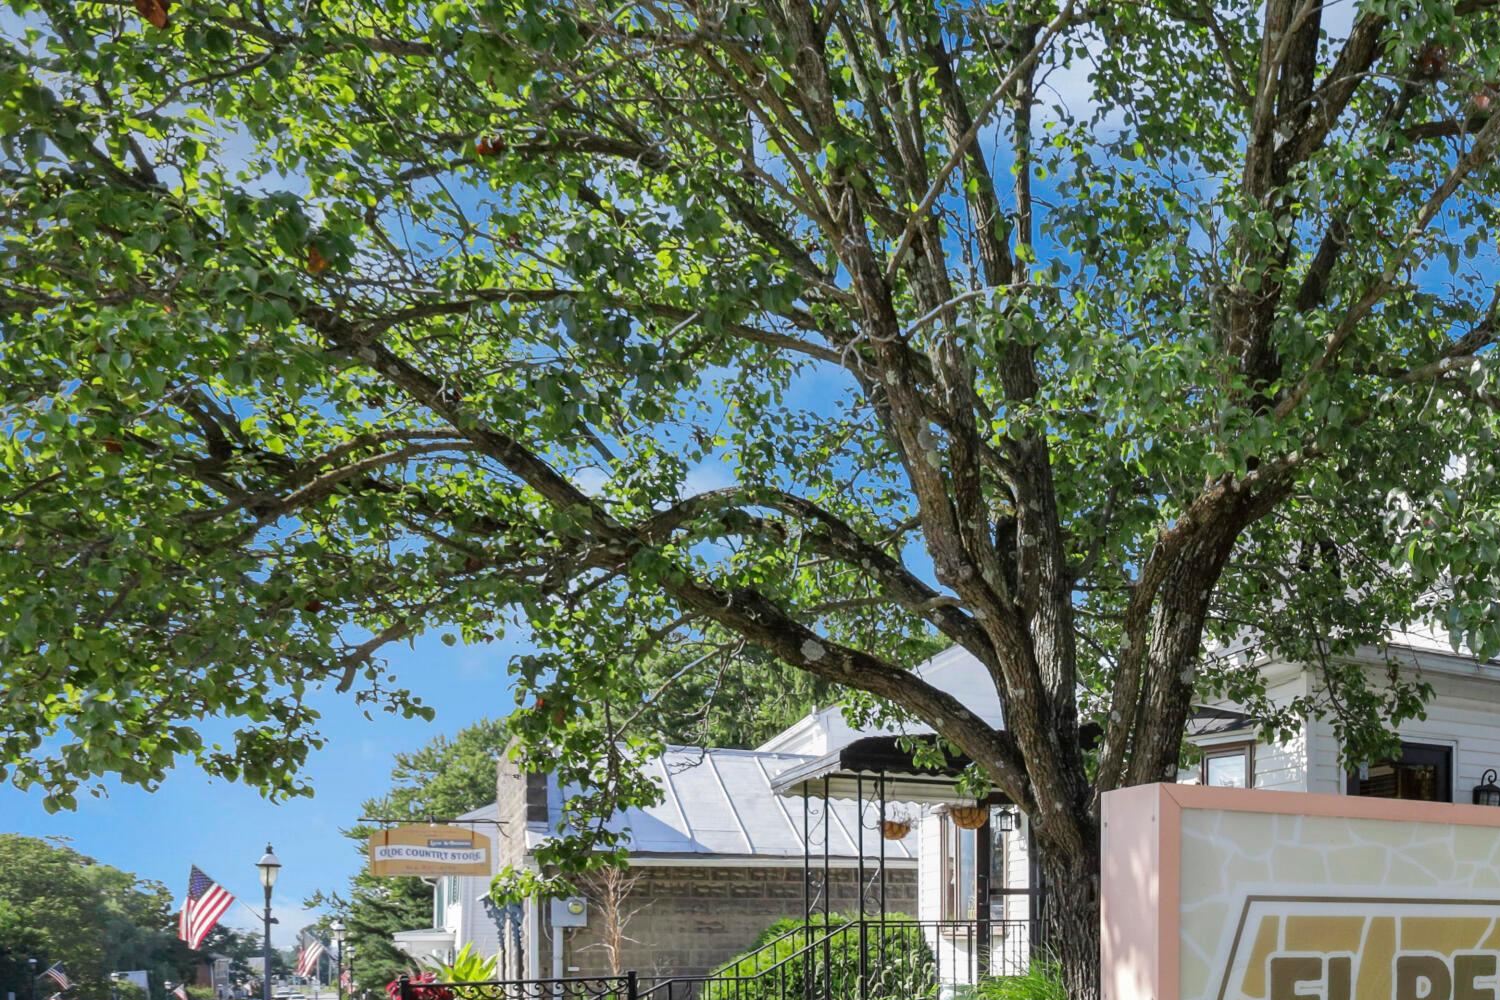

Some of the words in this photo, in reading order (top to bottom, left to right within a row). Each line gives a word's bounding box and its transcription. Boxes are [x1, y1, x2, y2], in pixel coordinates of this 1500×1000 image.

[380, 848, 403, 858] OLDE
[405, 848, 448, 861] COUNTRY
[450, 851, 481, 861] STORE
